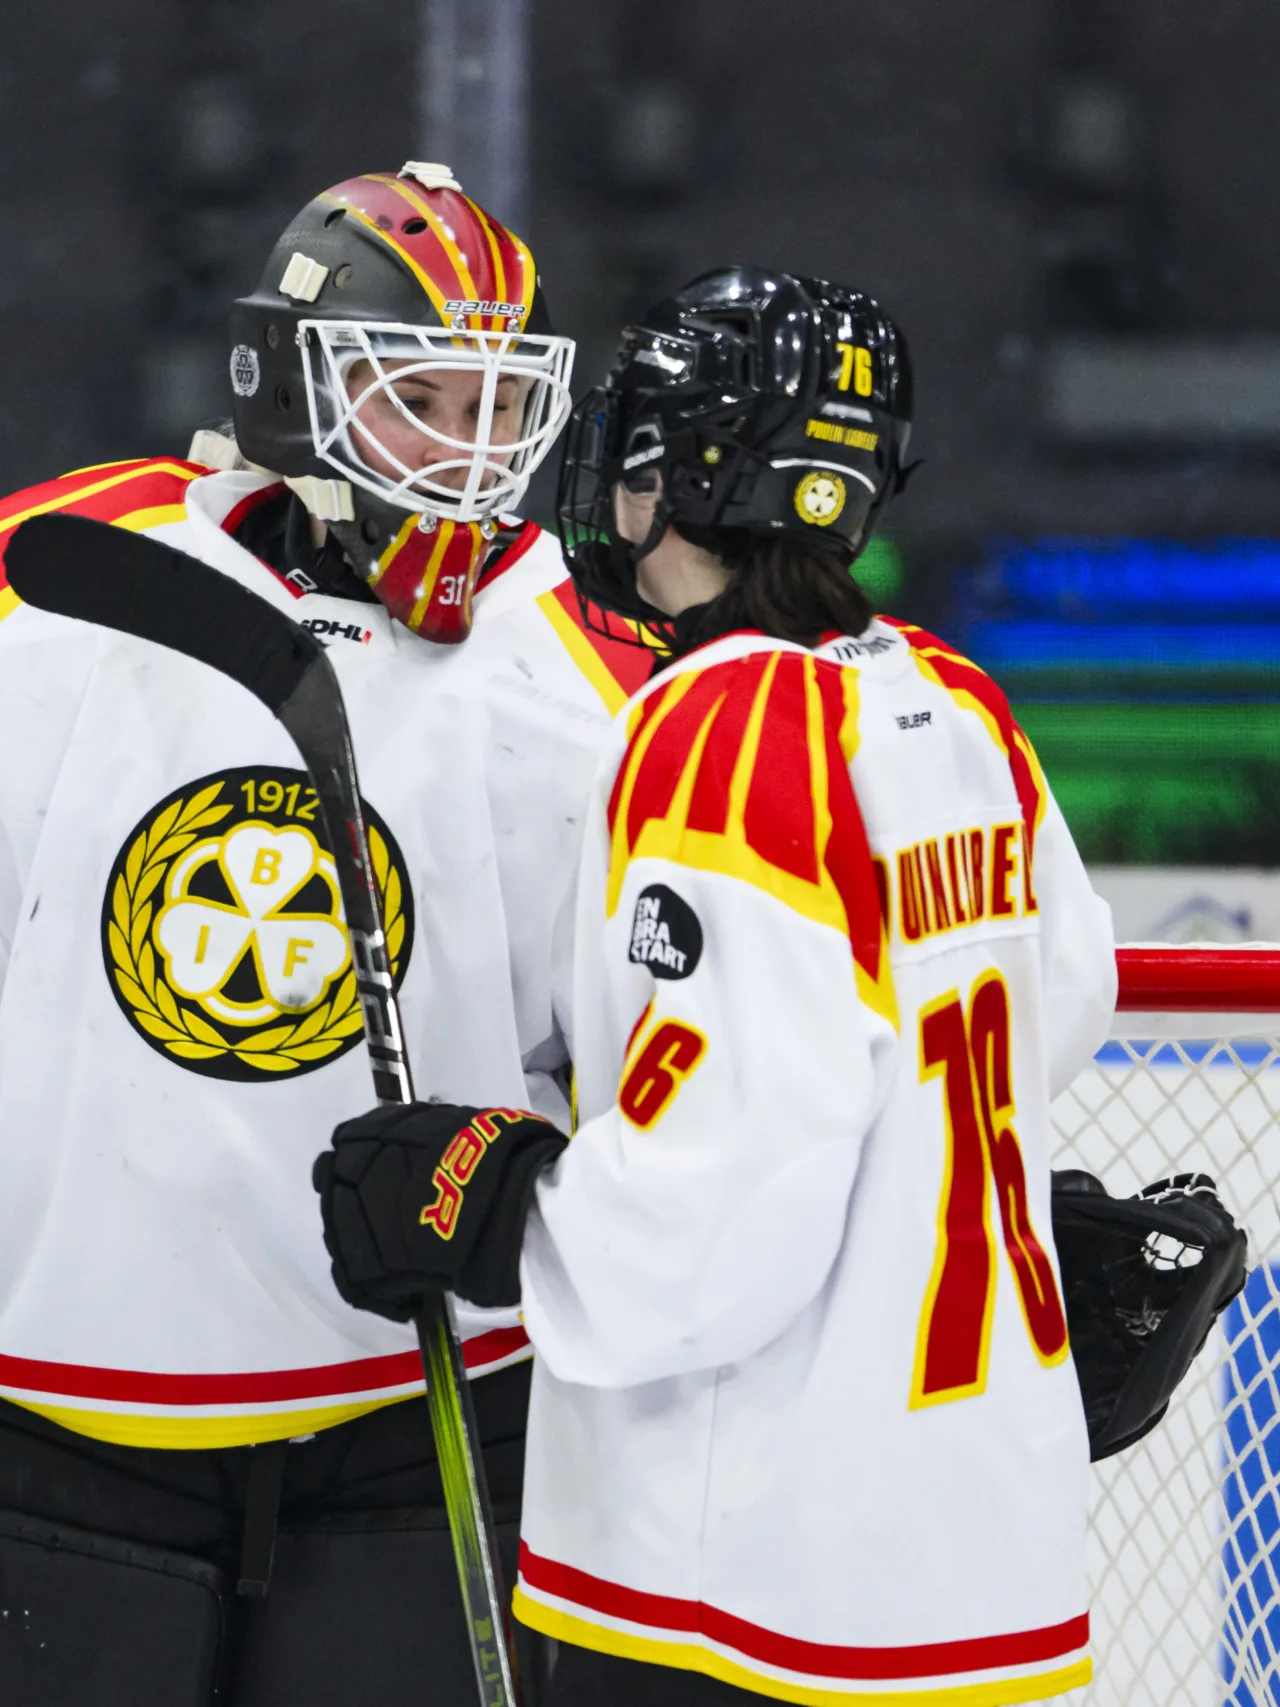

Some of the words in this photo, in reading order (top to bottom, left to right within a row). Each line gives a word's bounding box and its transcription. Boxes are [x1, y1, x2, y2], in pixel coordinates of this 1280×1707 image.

[443, 300, 526, 318] BAUER
[836, 342, 873, 398] 76
[438, 574, 466, 606] 31
[240, 779, 320, 821] 1912
[249, 846, 283, 886] B
[193, 924, 212, 965] I
[282, 937, 315, 978] F
[616, 995, 710, 1134] 6
[419, 1106, 554, 1241] UER
[908, 967, 1072, 1412] 76
